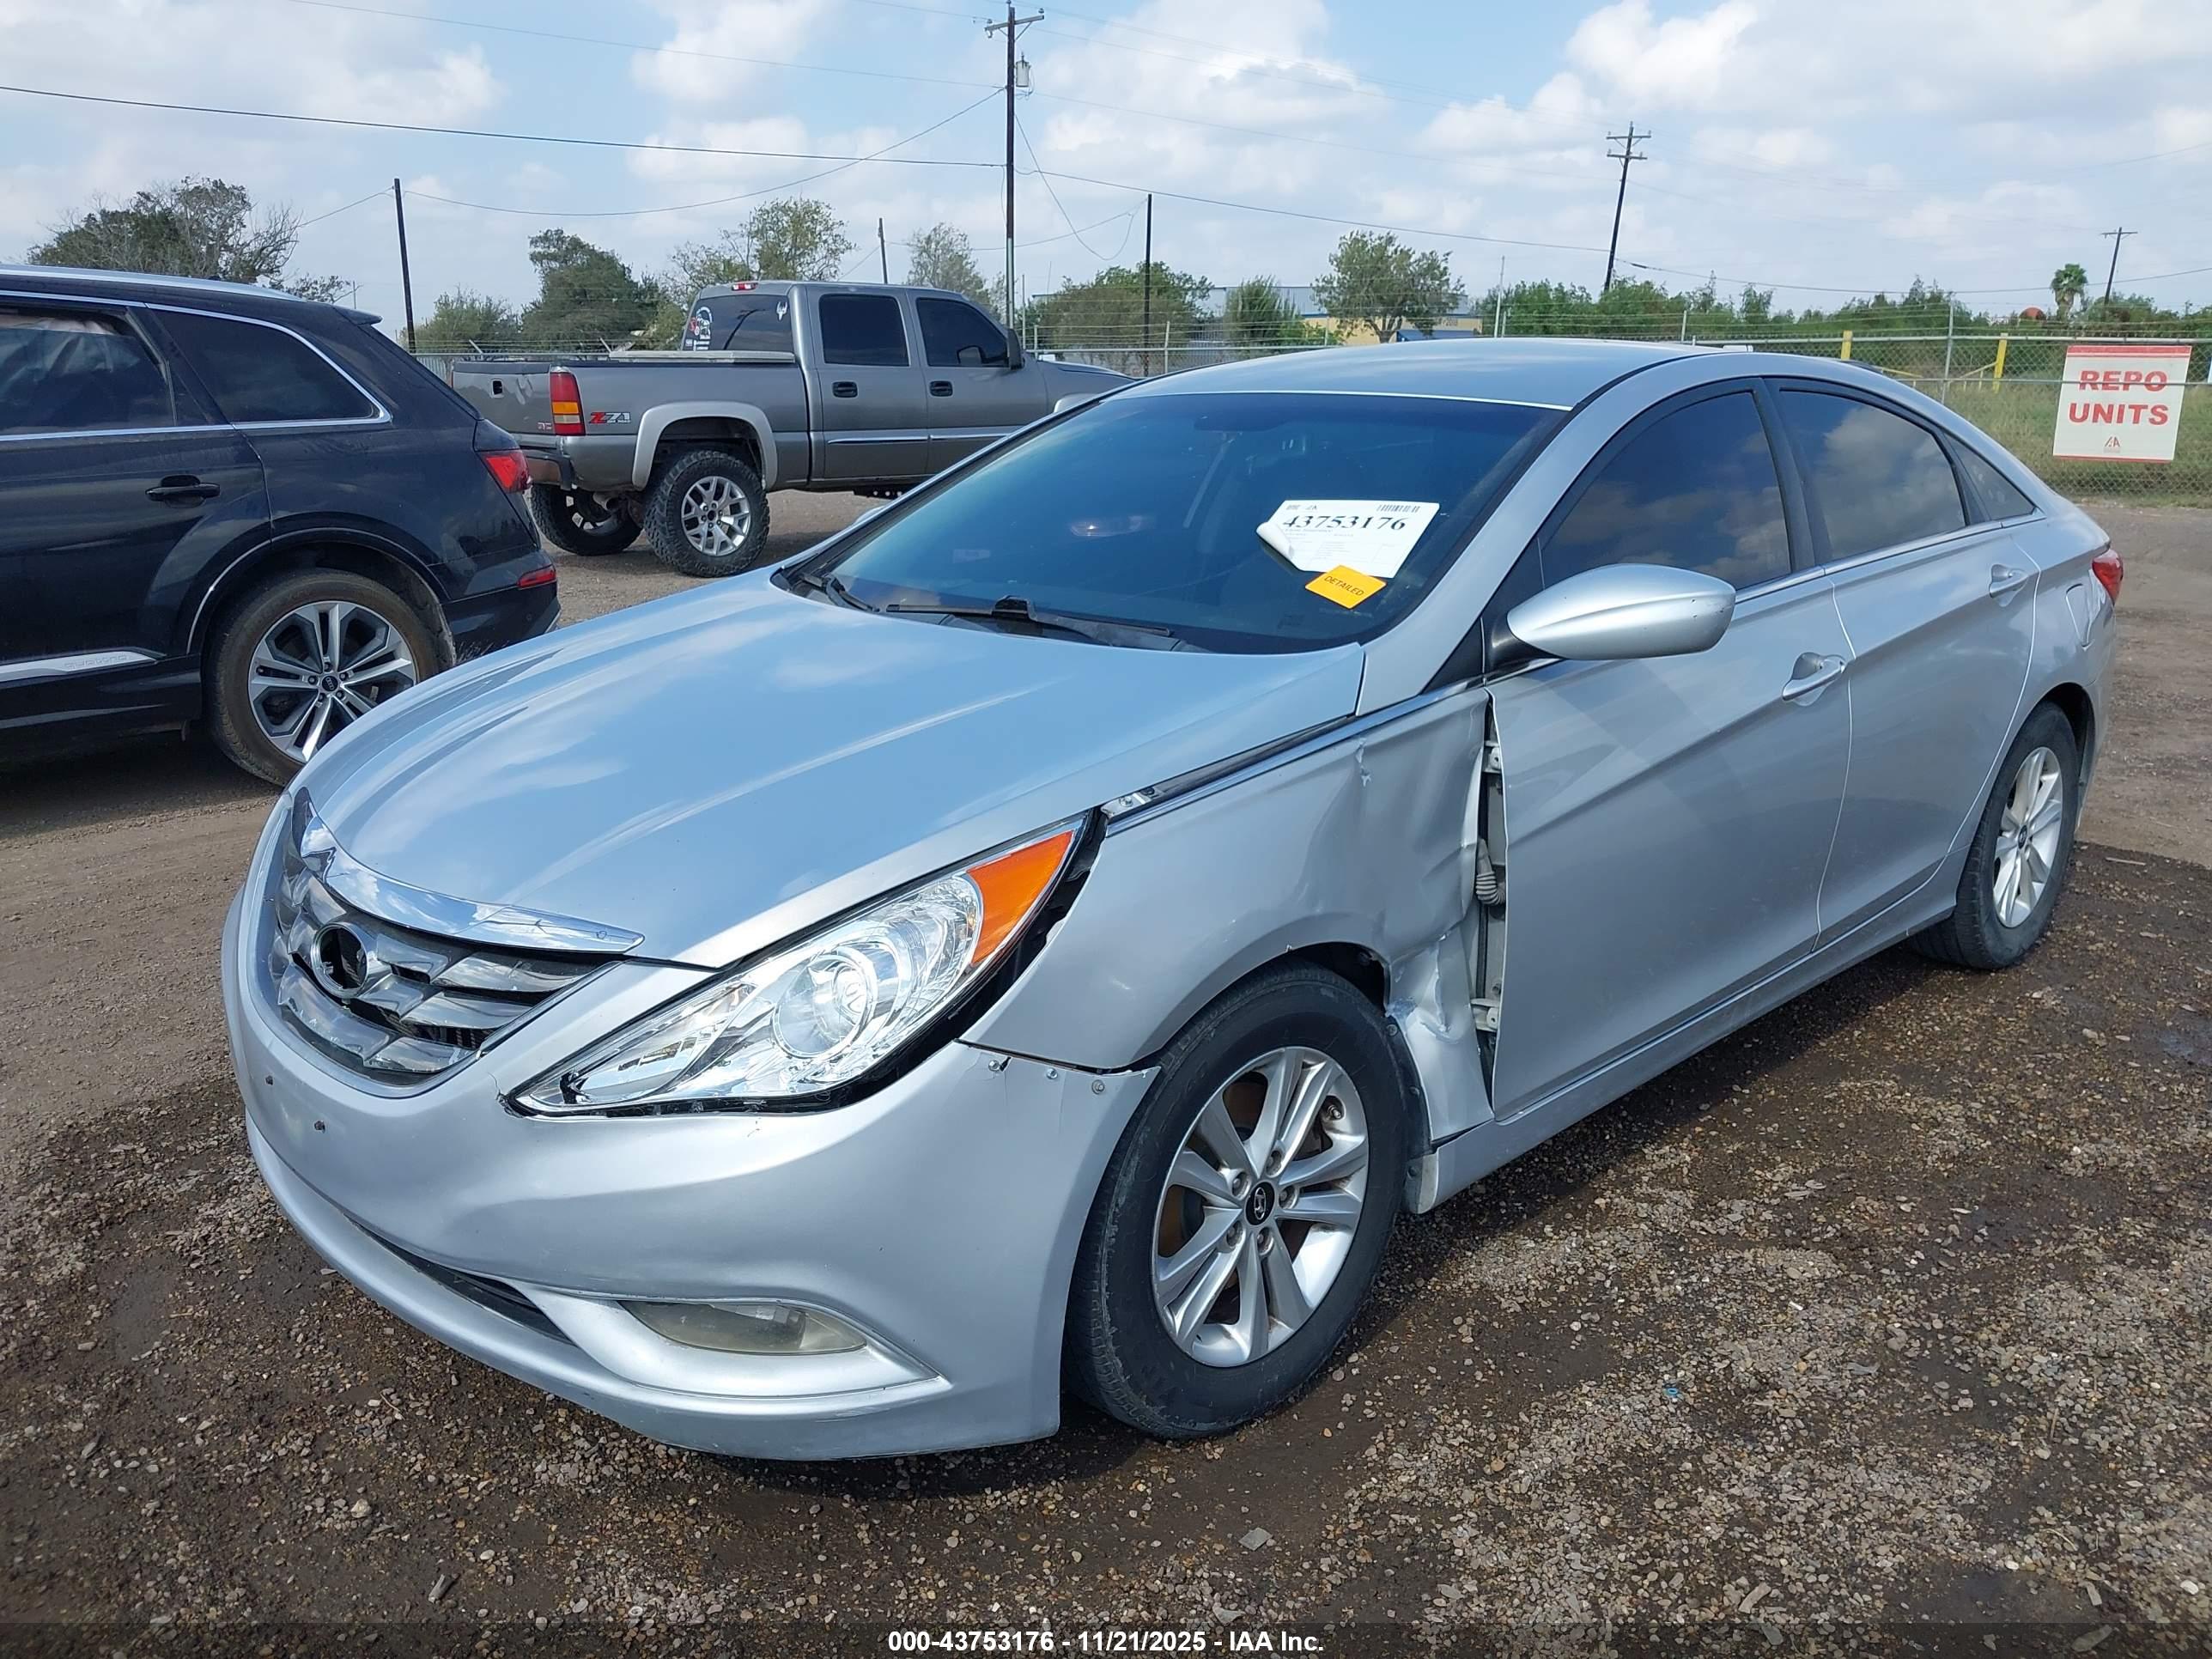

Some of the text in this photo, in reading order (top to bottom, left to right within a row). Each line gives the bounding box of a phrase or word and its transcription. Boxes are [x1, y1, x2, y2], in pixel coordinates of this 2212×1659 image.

[2078, 370, 2168, 392] REPO
[589, 411, 631, 423] Z71
[2069, 403, 2169, 425] UNITS
[1282, 515, 1407, 531] 43753176
[1323, 575, 1364, 597] DETAILED
